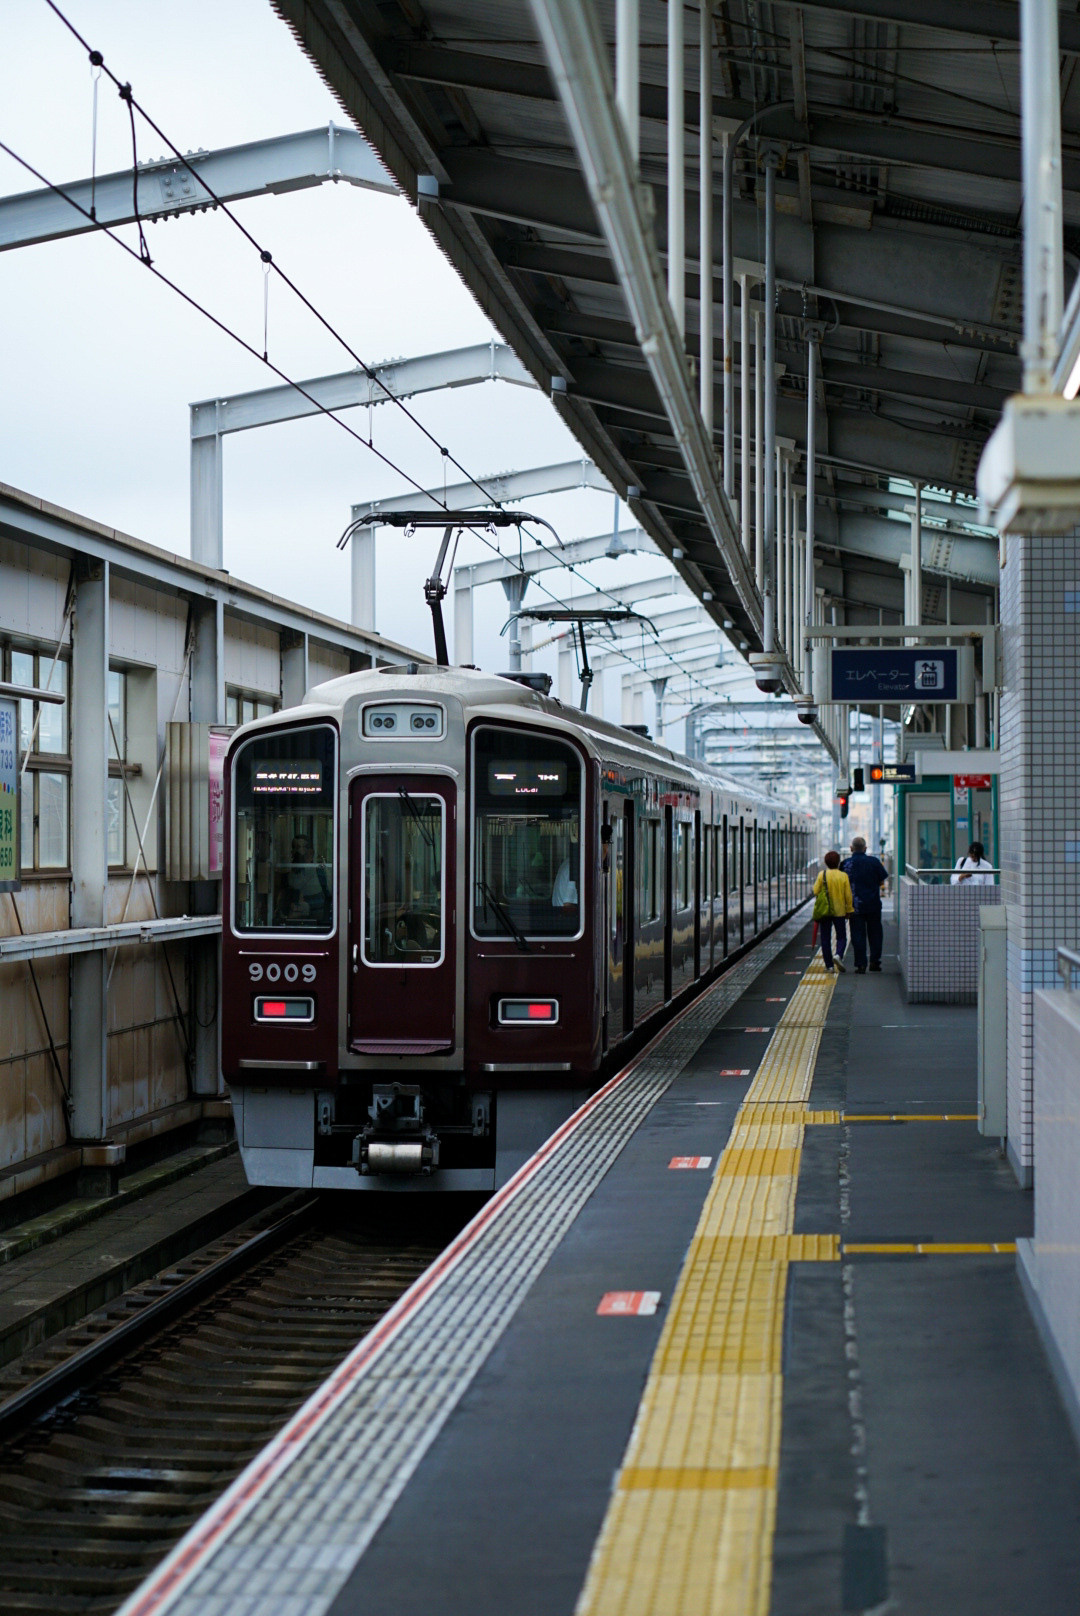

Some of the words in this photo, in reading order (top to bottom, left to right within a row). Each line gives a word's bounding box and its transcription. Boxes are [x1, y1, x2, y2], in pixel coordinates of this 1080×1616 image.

[845, 670, 910, 681] エレベーター
[878, 683, 909, 691] Elevato
[248, 962, 317, 983] 9009
